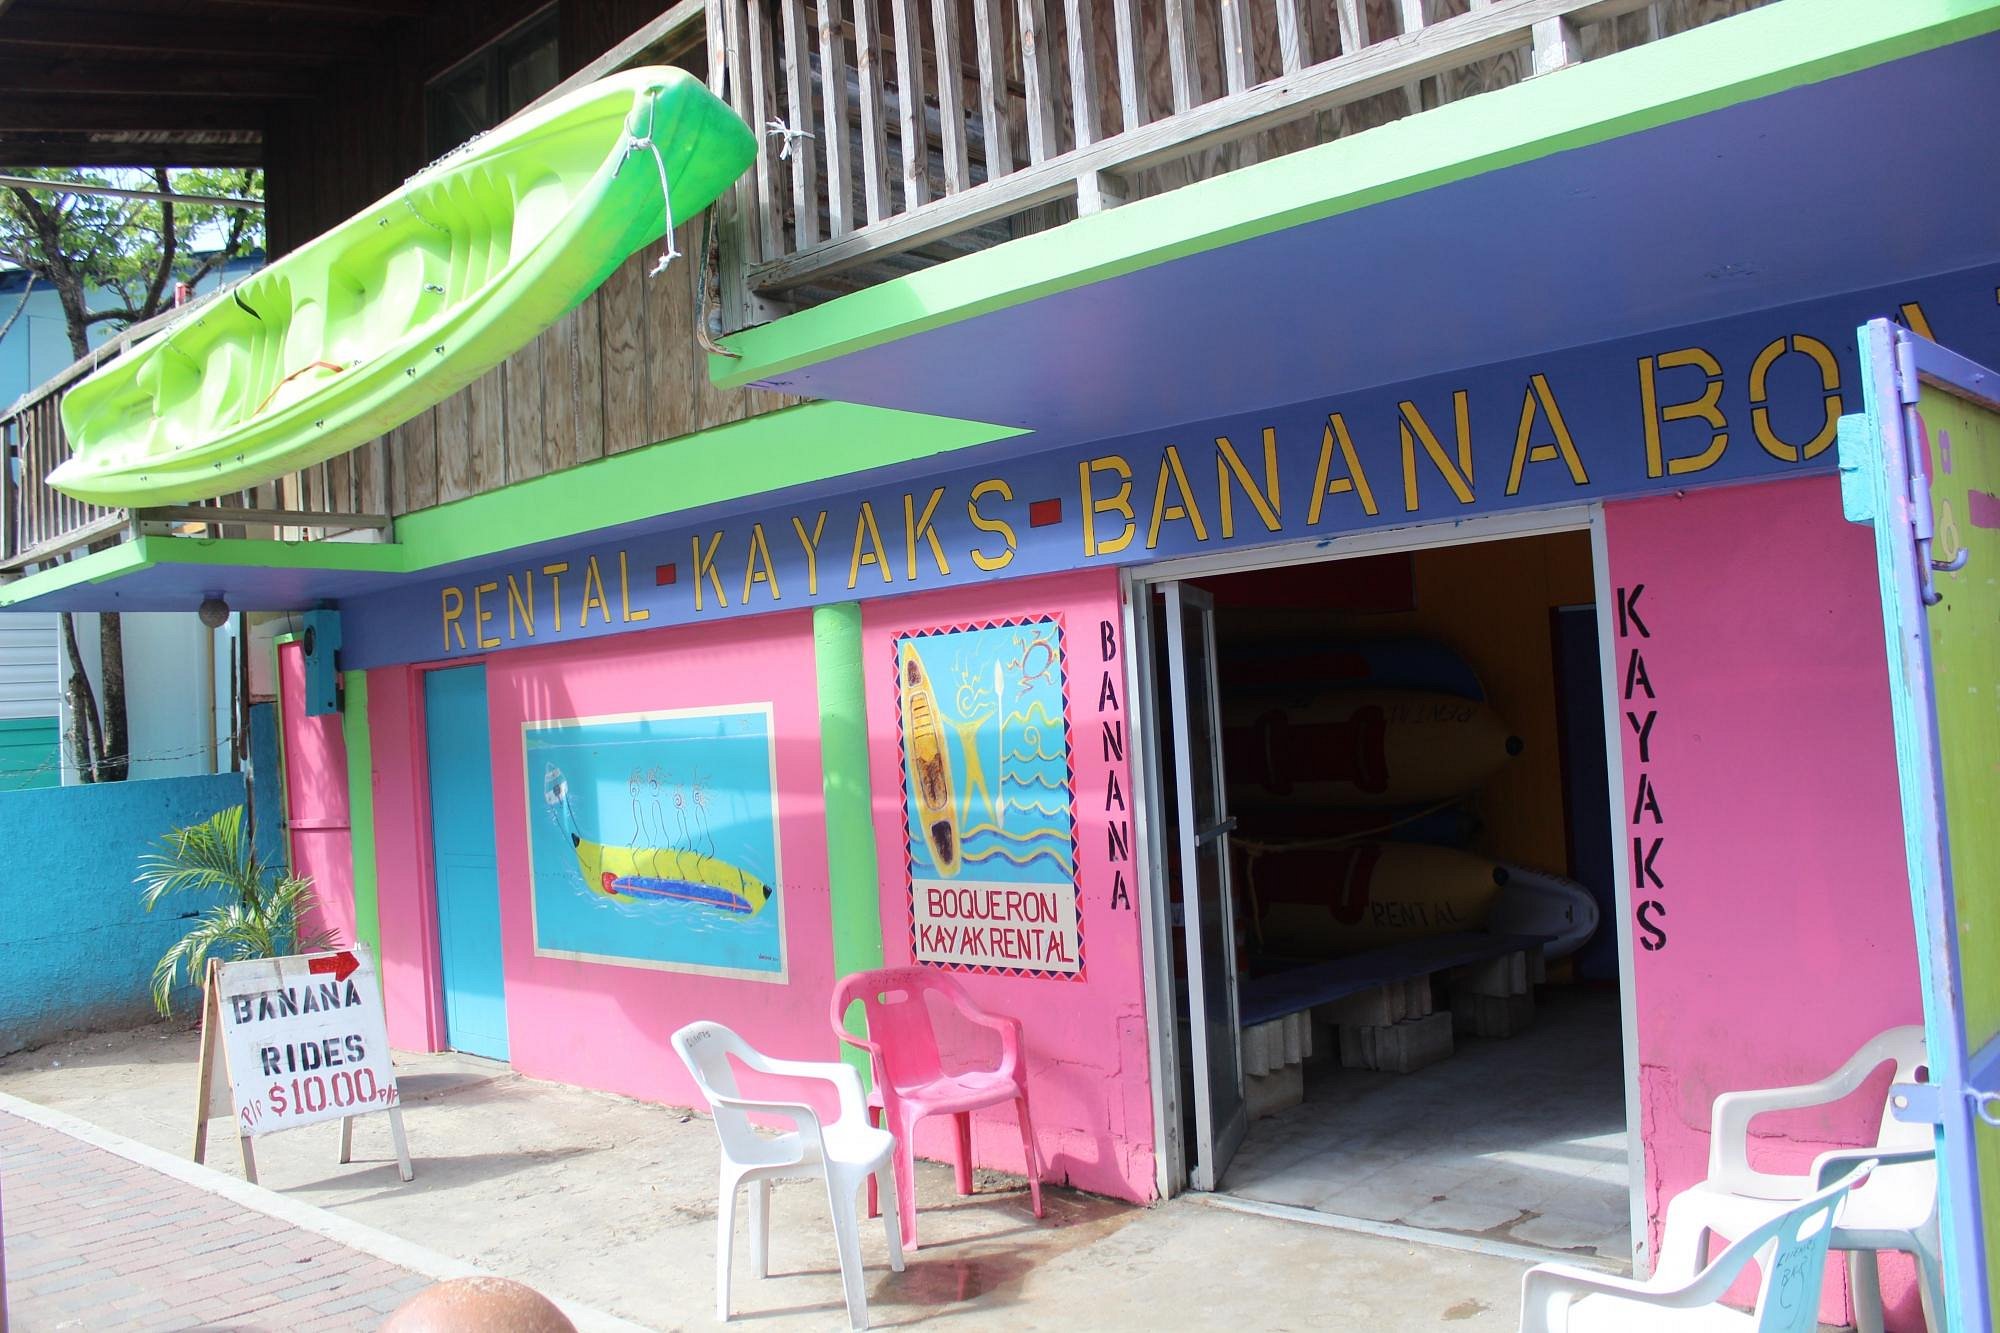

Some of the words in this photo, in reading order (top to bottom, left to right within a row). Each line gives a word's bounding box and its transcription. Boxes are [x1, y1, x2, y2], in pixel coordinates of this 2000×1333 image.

[442, 551, 650, 652] RENTAL
[691, 477, 1017, 611] KAYAKS
[1078, 373, 1591, 557] BANANA
[1099, 620, 1131, 911] BANANA
[1617, 583, 1667, 951] KAYAKS
[927, 888, 1058, 924] BOQUERON
[1371, 901, 1467, 928] RENTAL
[919, 923, 985, 957] KAYAK
[991, 927, 1075, 964] RENTAL
[232, 979, 362, 1025] BANANA
[260, 1034, 366, 1077] RIDES
[268, 1068, 378, 1117] $10.00
